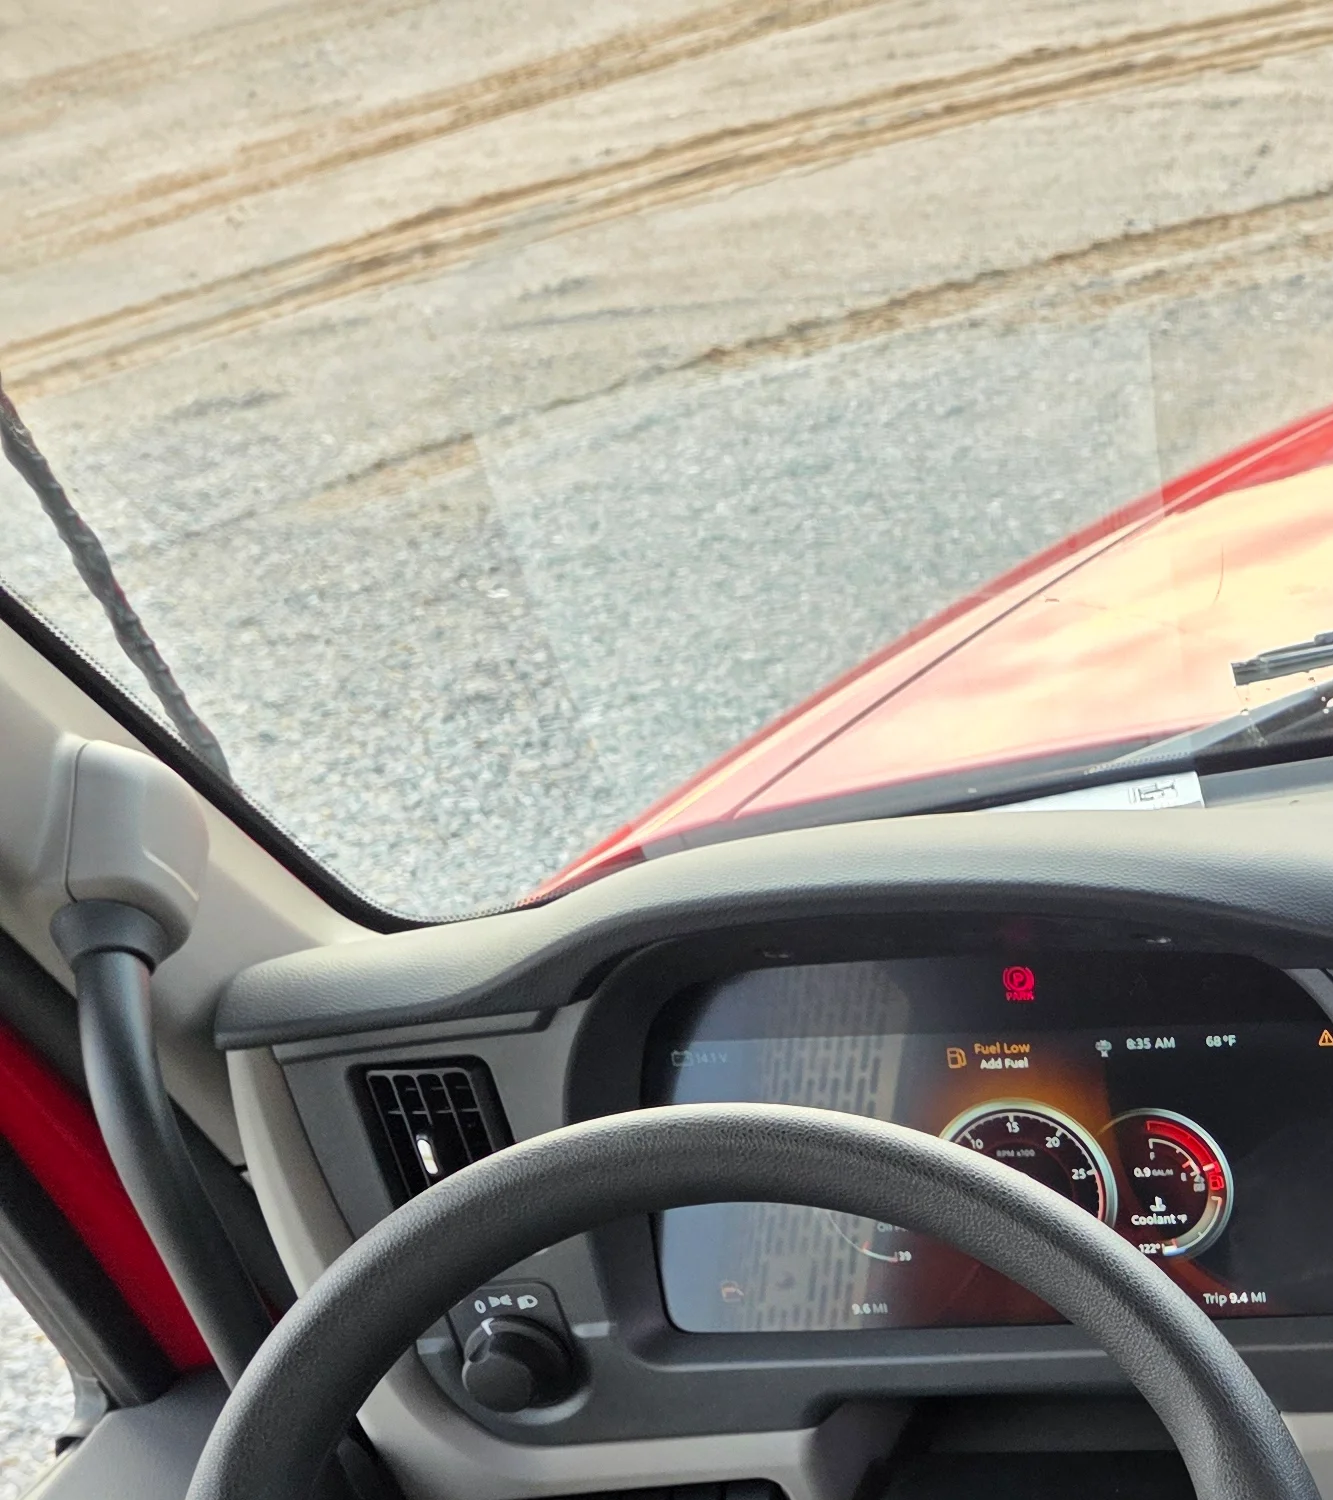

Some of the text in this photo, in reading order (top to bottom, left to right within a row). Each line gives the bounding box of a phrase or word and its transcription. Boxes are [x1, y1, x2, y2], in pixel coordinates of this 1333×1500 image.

[1006, 992, 1035, 1001] PARK
[974, 1042, 1030, 1055] Fuel Low
[1126, 1036, 1175, 1050] 8:35 AM
[980, 1057, 1028, 1070] Add Fuel
[1006, 1122, 1020, 1134] 15
[972, 1139, 984, 1151] 10
[1045, 1136, 1060, 1149] 20
[1072, 1168, 1086, 1180] 25
[1131, 1213, 1177, 1225] Coolant
[1203, 1292, 1267, 1307] Trip 9.4 MI
[852, 1303, 888, 1315] 9.6 MI
